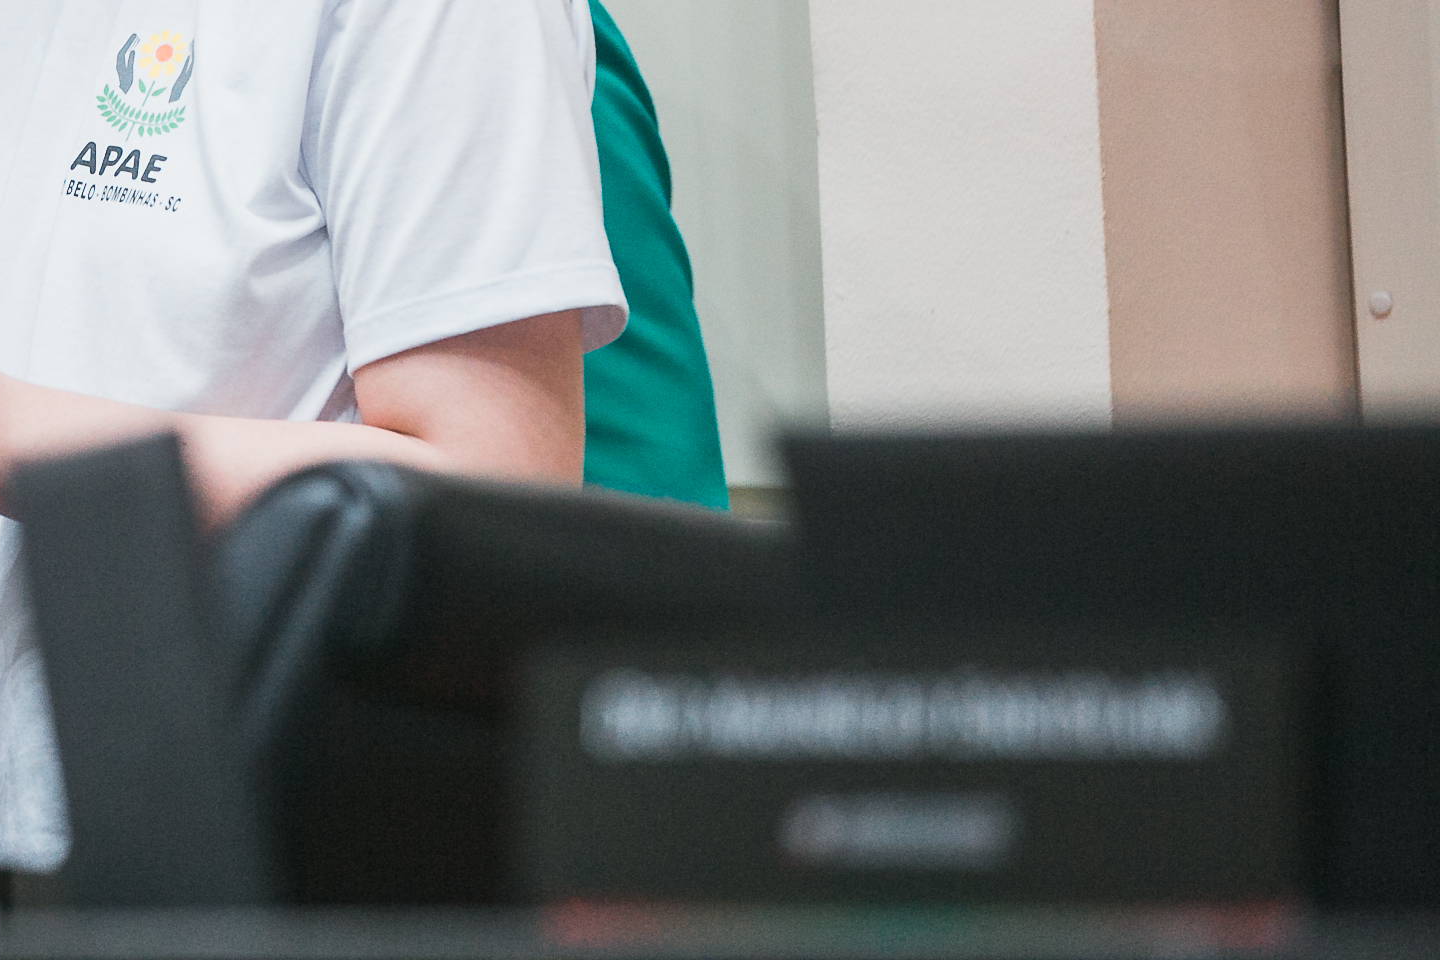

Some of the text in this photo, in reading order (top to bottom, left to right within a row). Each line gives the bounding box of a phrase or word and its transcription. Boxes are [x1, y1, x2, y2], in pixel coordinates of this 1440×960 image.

[70, 141, 168, 183] APAE
[65, 179, 96, 201] BELO
[164, 196, 182, 212] SC
